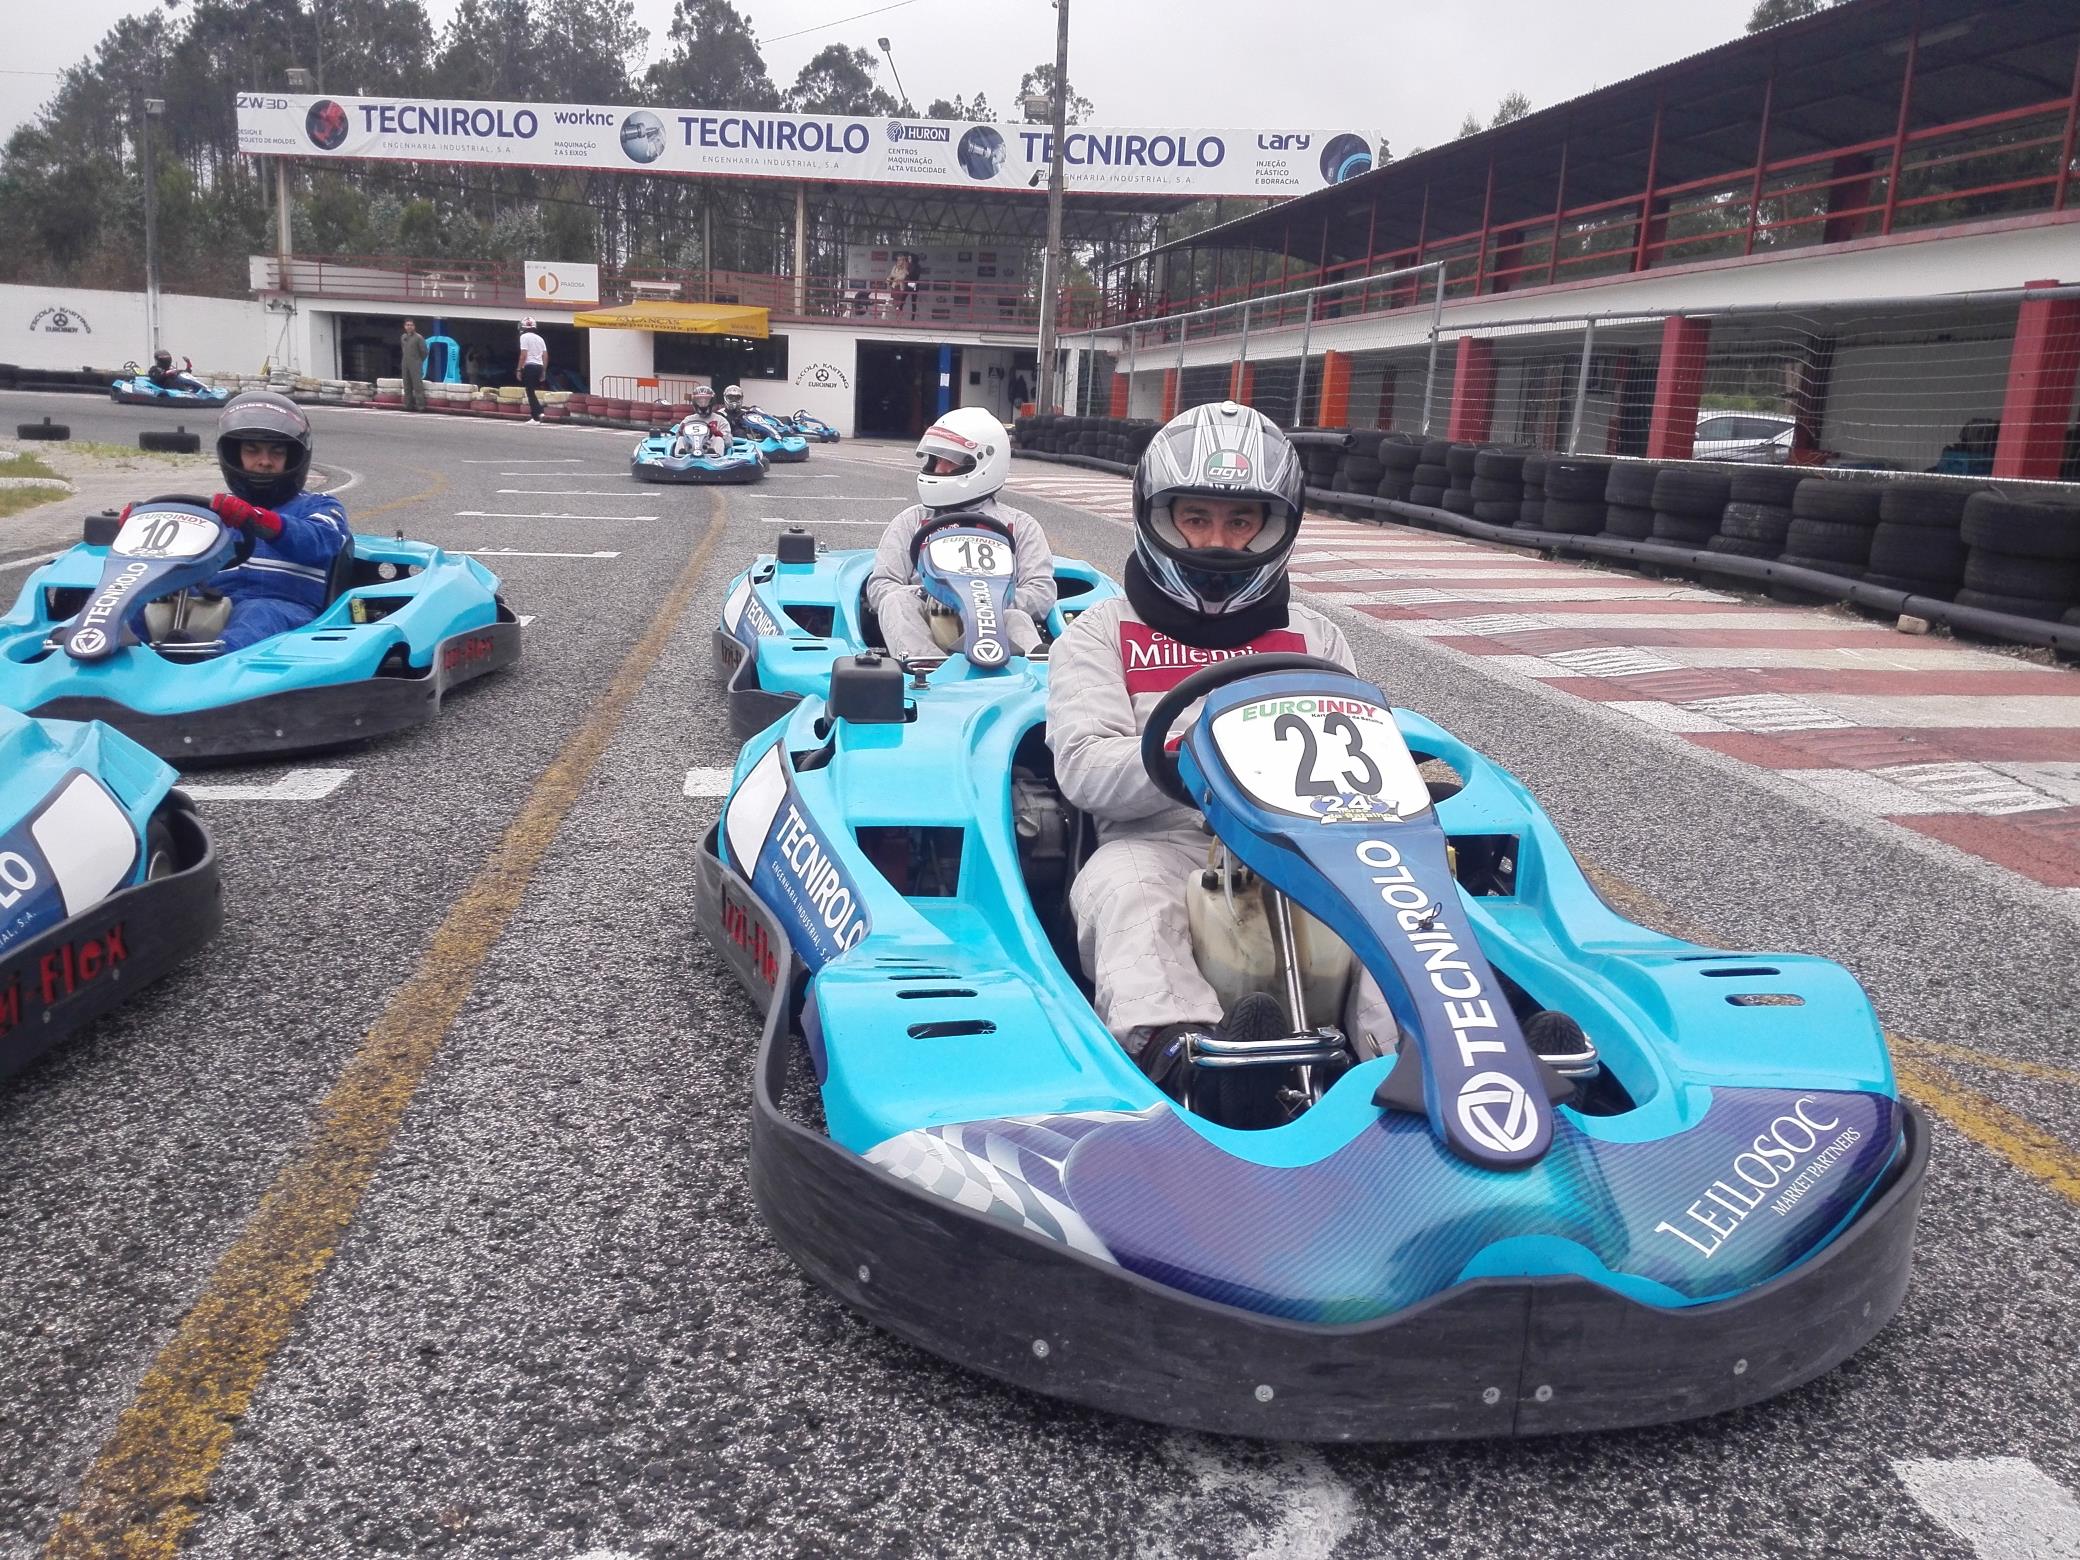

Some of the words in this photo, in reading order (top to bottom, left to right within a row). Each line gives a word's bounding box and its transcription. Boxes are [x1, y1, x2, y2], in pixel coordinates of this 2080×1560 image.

[237, 97, 288, 110] ZW3D
[359, 105, 538, 139] TECNIROLO
[554, 108, 614, 126] worknc
[678, 117, 870, 154] TECNIROLO
[908, 127, 947, 140] HURON
[383, 141, 437, 150] ENGENHARIA
[888, 148, 918, 156] CENTROS
[1019, 132, 1226, 168] TECNIROLO
[702, 155, 760, 165] ENGENHARIA
[887, 157, 933, 166] MAQUINAÇÃO
[1256, 160, 1287, 168] INJEÇÃO
[905, 166, 947, 174] VELOCIDADE
[1255, 167, 1290, 176] PLÁSTICO
[795, 363, 819, 386] ESCOLA
[822, 363, 850, 389] KARTING
[1208, 465, 1249, 480] agv
[137, 513, 208, 526] EUROINDY
[142, 518, 180, 551] 10
[942, 536, 1004, 547] EUROINDY
[958, 540, 996, 571] 18
[1243, 700, 1377, 722] EUROINDY
[1273, 712, 1383, 797] 23
[1321, 795, 1374, 812] 24
[771, 860, 799, 906] ENGENHARIA
[1355, 839, 1510, 1068] TECNIROLO
[1654, 1096, 1839, 1259] LEILOSOC
[1770, 1169, 1815, 1217] MARKET
[1806, 1126, 1861, 1179] PARTNERS
